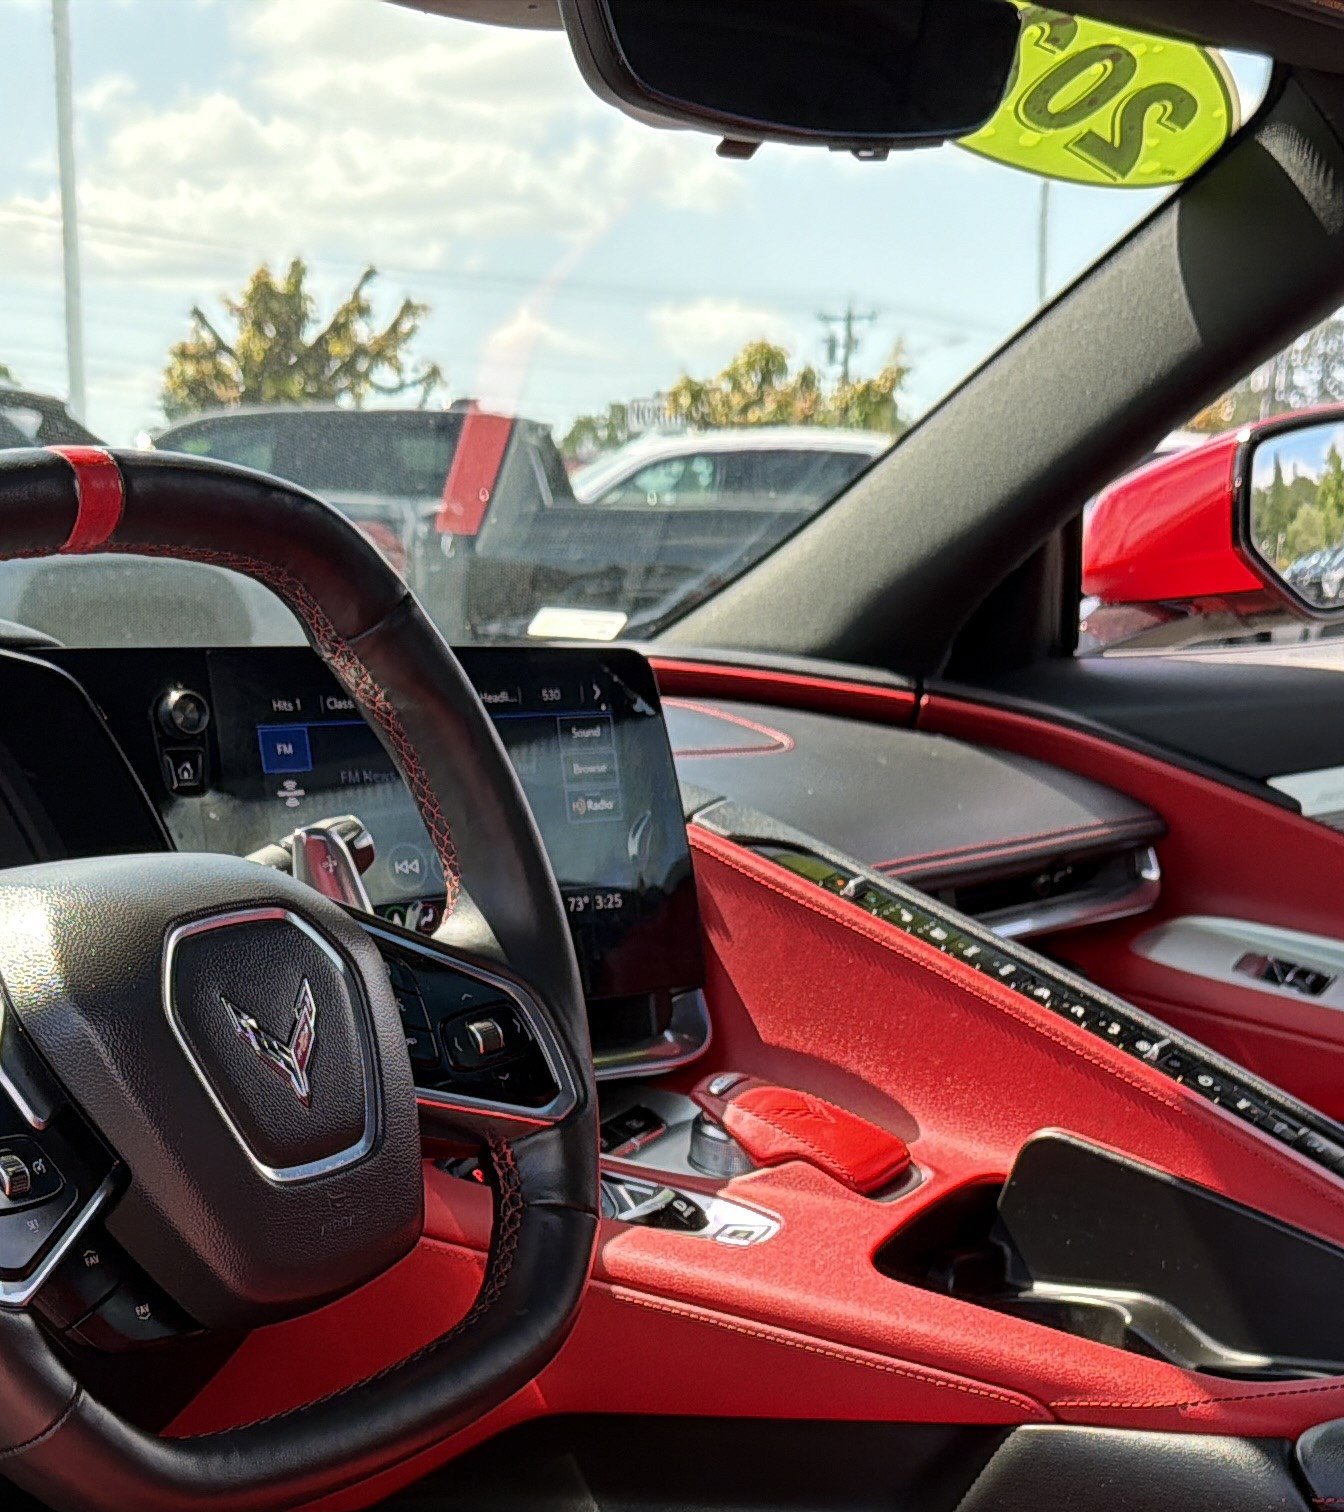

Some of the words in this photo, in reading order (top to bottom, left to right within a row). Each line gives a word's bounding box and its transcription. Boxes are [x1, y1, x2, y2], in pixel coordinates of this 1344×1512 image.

[272, 699, 294, 712] Hits
[326, 696, 355, 710] Class
[571, 726, 601, 739] Sound
[276, 743, 294, 756] FM
[572, 763, 608, 775] Browse
[340, 769, 360, 783] FM
[586, 798, 614, 811] Radio
[595, 893, 624, 911] 3:25
[85, 1253, 100, 1267] FAV
